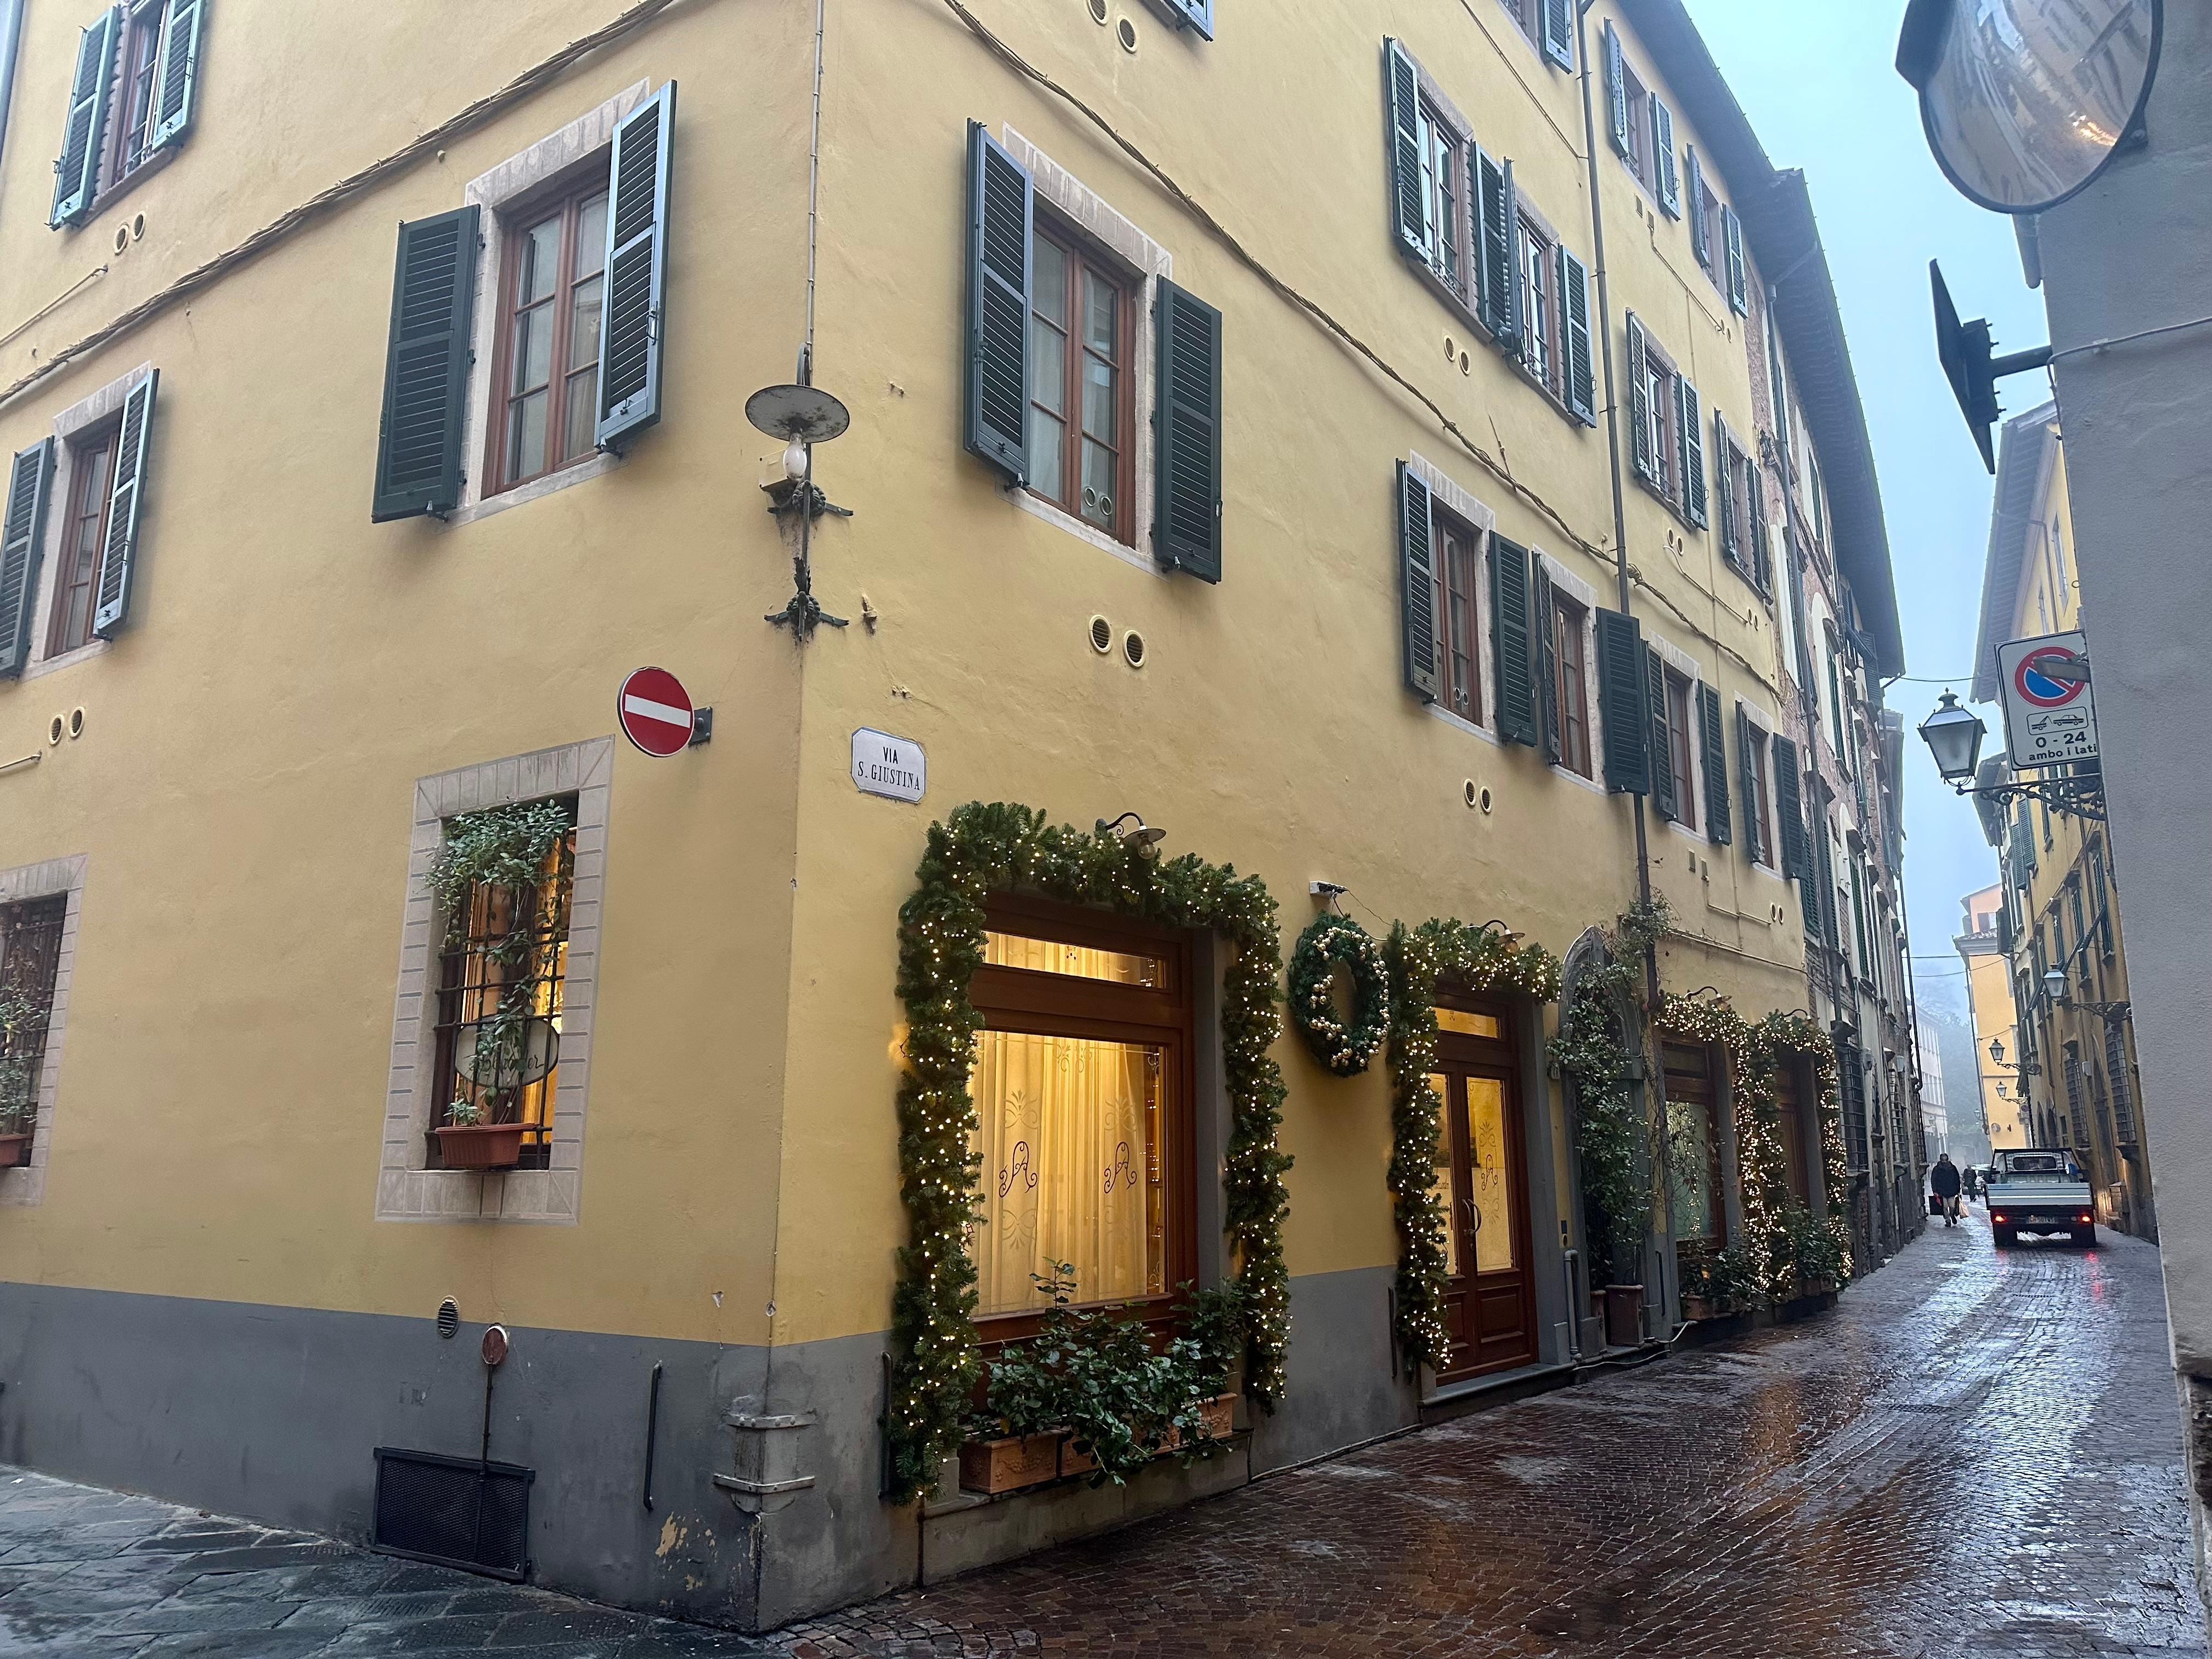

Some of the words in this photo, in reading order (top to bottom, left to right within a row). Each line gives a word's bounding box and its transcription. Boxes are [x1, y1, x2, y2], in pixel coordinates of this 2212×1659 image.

[2063, 731, 2086, 744] 24
[883, 747, 899, 764] VIA
[2029, 749, 2063, 761] ambo
[2067, 747, 2071, 756] i
[2075, 743, 2097, 755] lati
[857, 761, 868, 778] S.
[871, 764, 920, 791] GIUSTINA
